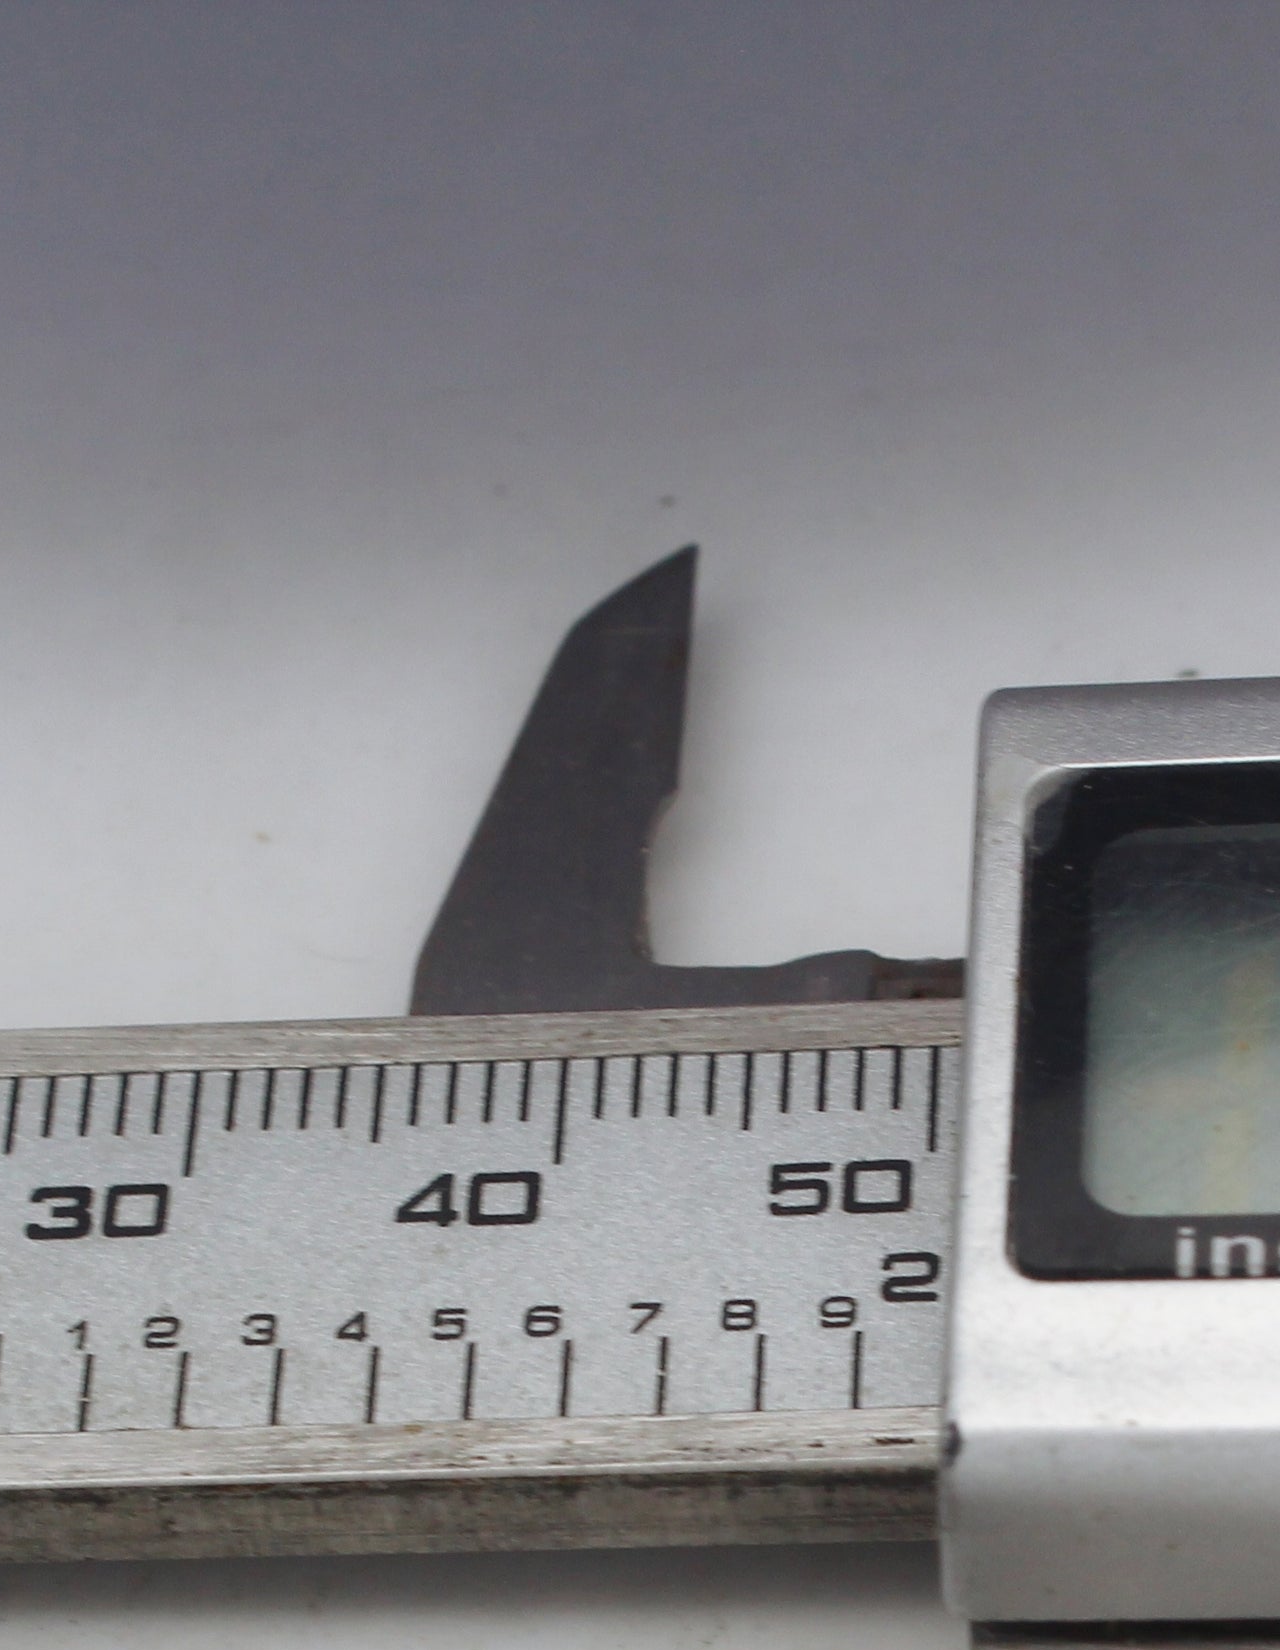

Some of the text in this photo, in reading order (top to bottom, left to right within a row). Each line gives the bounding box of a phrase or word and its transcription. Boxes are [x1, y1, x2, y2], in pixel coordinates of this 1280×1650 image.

[26, 1184, 169, 1240] 30
[395, 1171, 542, 1227] 40
[770, 1160, 912, 1216] 50
[883, 1253, 939, 1302] 2
[67, 1321, 88, 1350] 1
[145, 1317, 180, 1348] 2
[243, 1314, 276, 1345] 3
[337, 1312, 368, 1342] 4
[433, 1309, 466, 1340] 5
[525, 1306, 561, 1337] 6
[629, 1302, 663, 1333] 7
[723, 1300, 756, 1331] 8
[821, 1296, 857, 1328] 9
